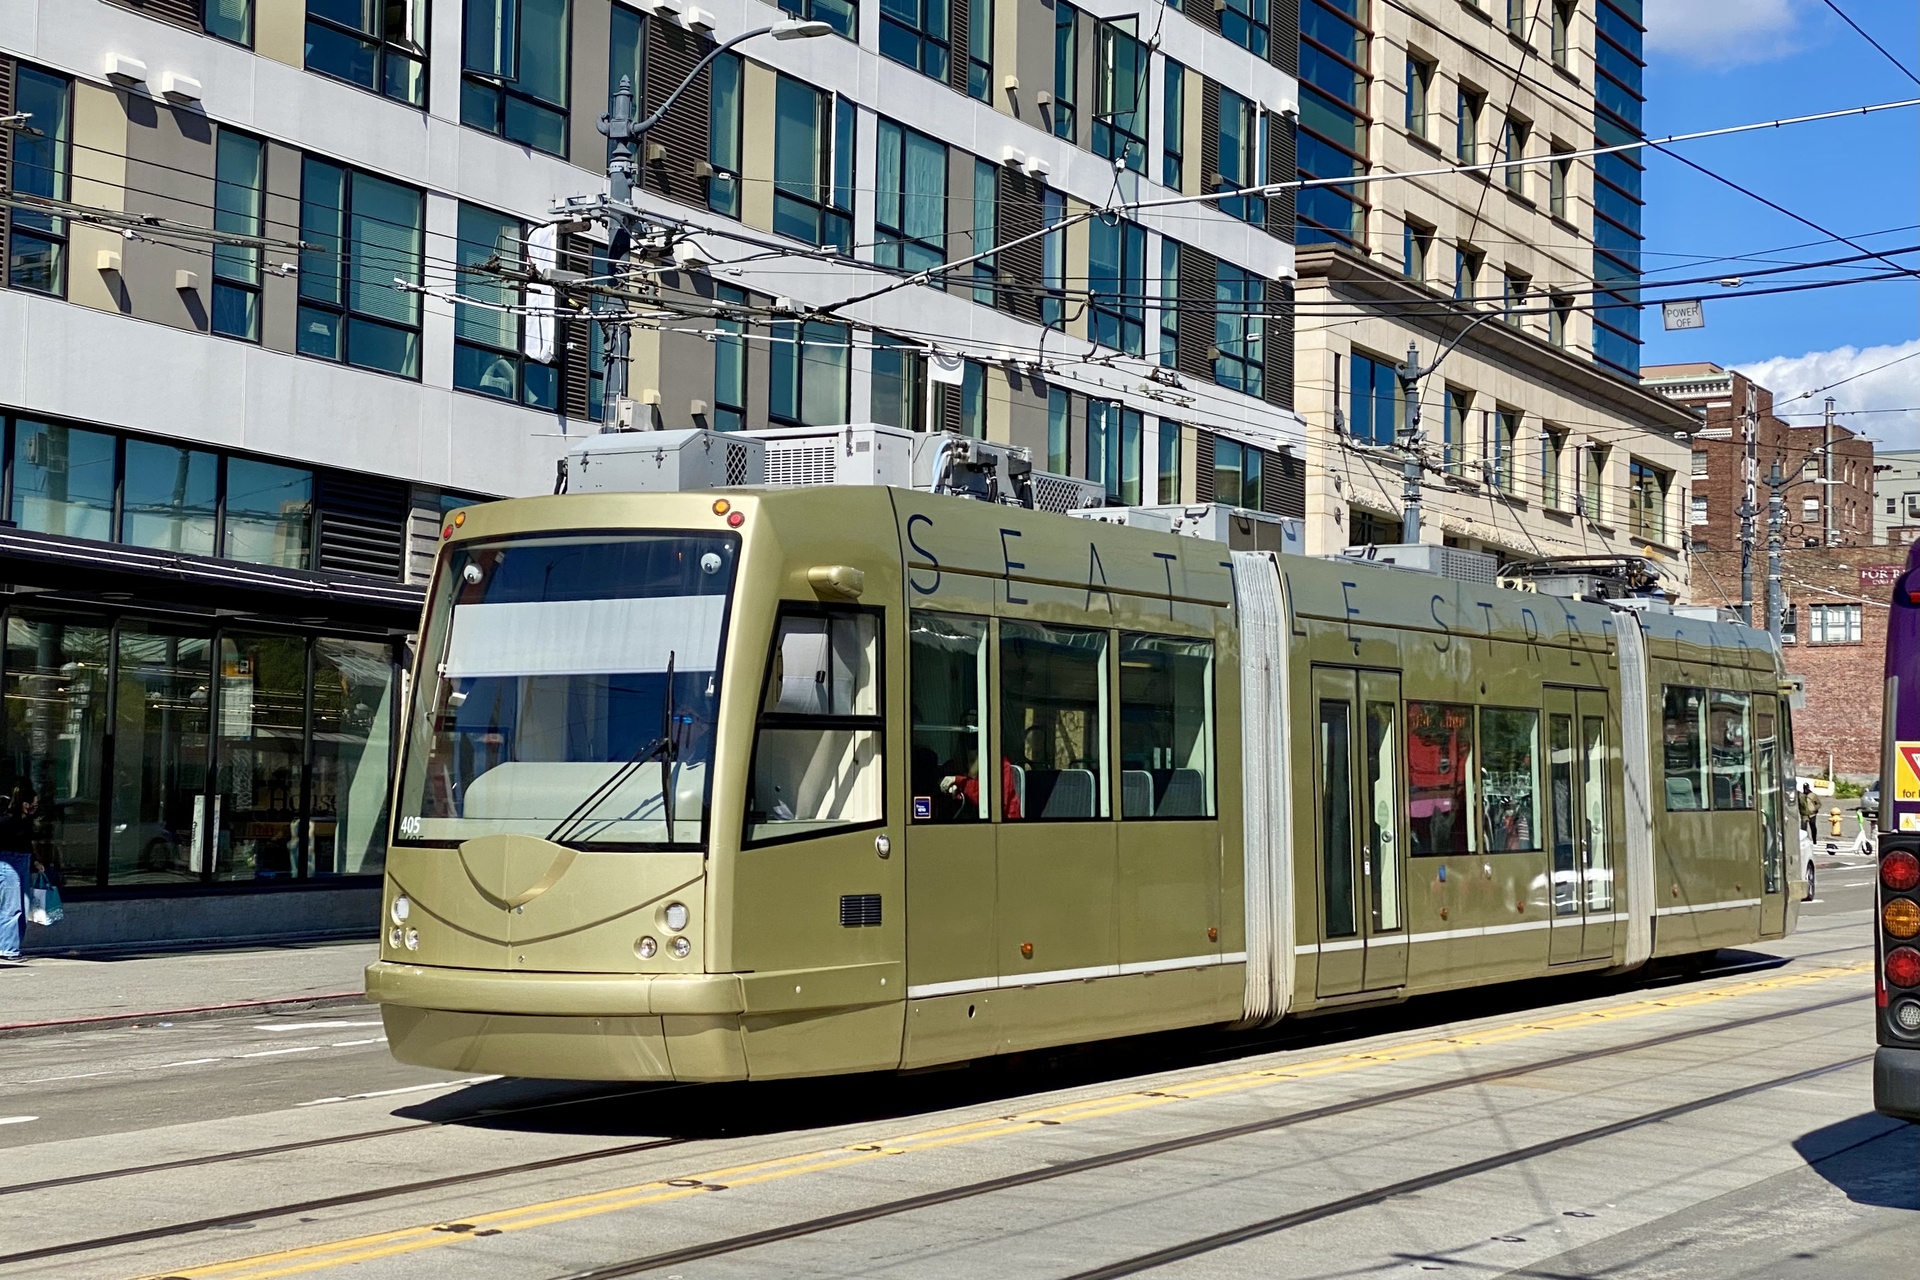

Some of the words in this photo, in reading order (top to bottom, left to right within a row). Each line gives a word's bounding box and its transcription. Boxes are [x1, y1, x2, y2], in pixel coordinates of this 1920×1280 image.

[1666, 306, 1699, 318] POWER
[1676, 318, 1692, 328] OFF
[906, 513, 1363, 643] SEATTLE
[1861, 569, 1888, 579] FOR
[1902, 789, 1915, 799] for
[400, 816, 421, 834] 405
